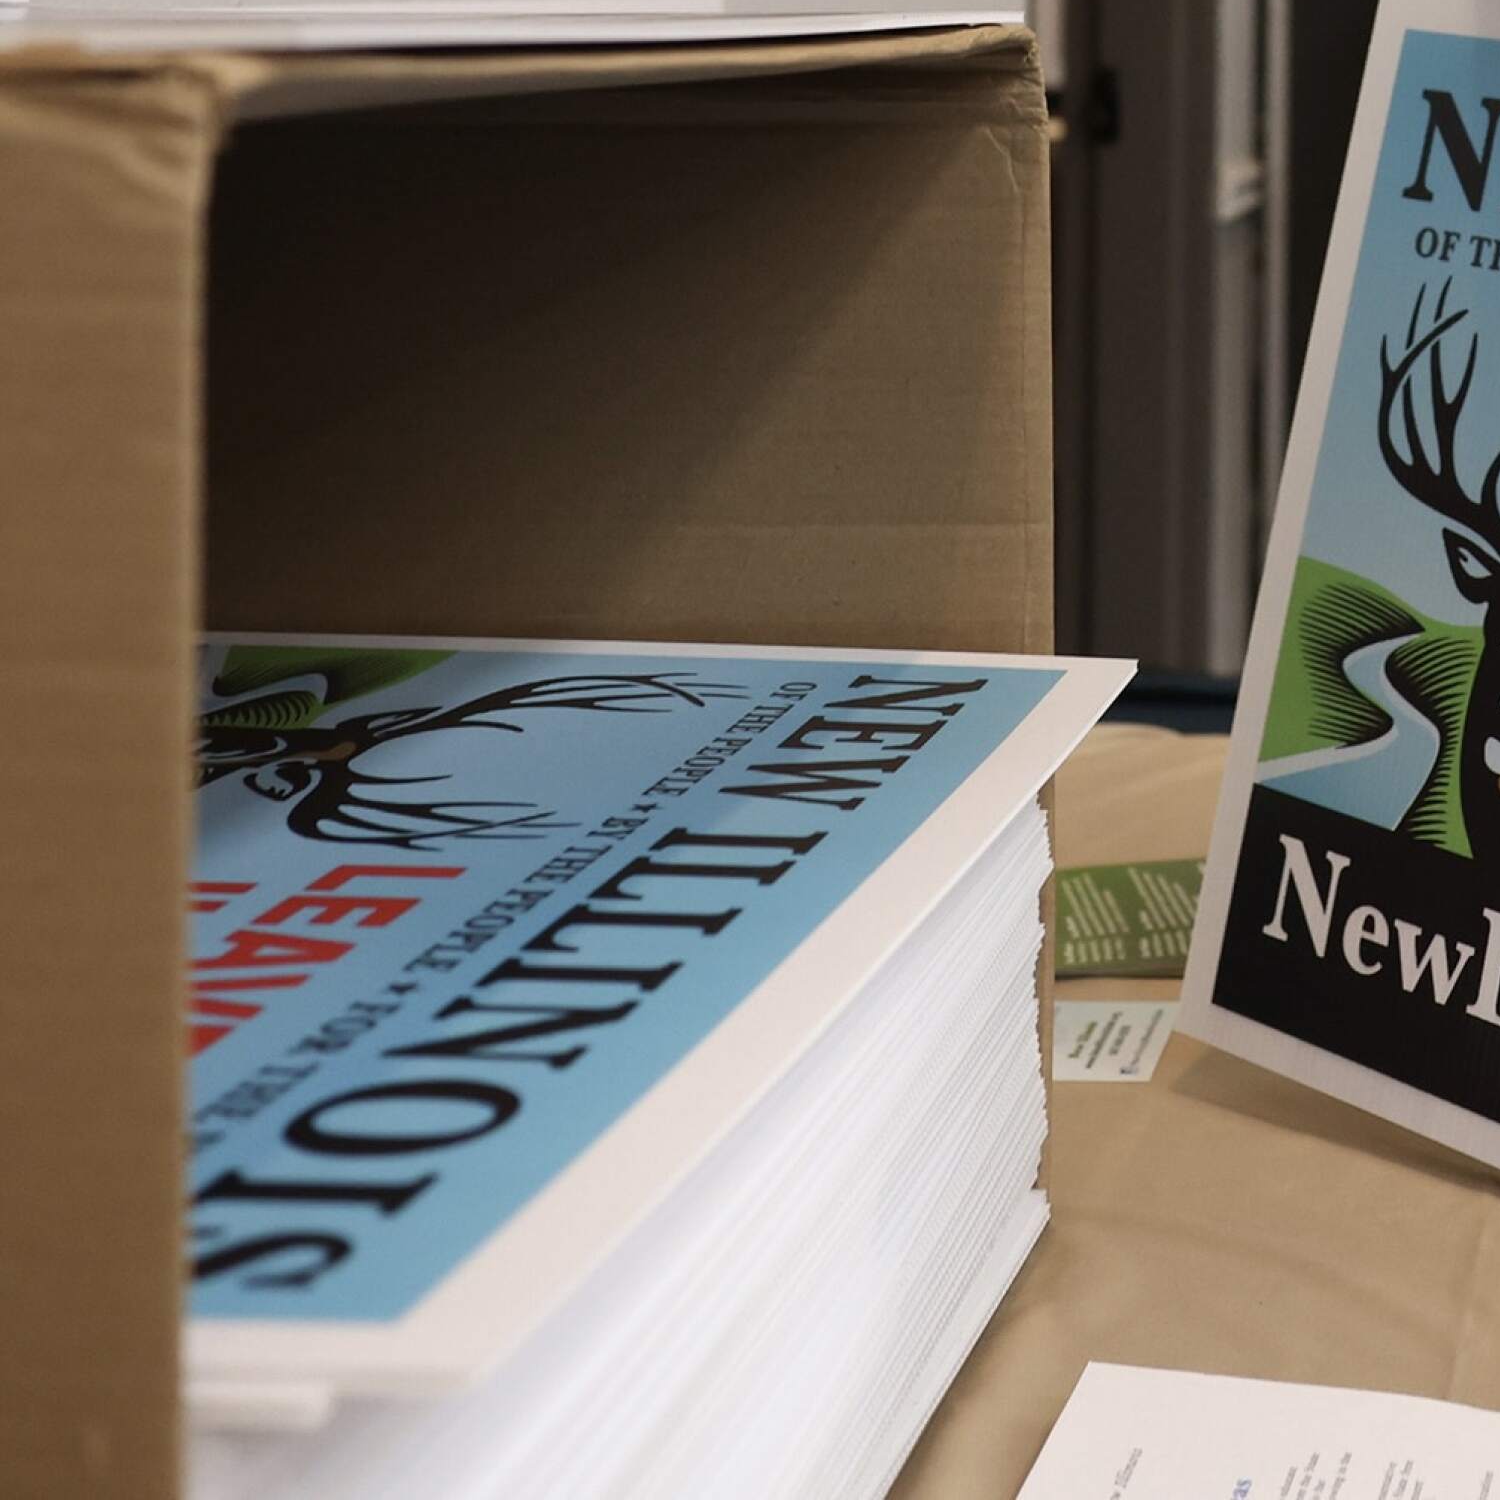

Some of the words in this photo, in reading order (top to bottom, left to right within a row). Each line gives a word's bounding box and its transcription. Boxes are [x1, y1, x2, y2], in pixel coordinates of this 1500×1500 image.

[1414, 226, 1461, 264] OF
[770, 681, 818, 701] OF
[725, 703, 795, 734] THE
[718, 674, 989, 811] NEW
[641, 737, 753, 797] PEOPLE
[586, 816, 649, 840] BY
[523, 844, 613, 884] THE
[405, 888, 554, 972] PEOPLE
[186, 865, 467, 1057] LEAV
